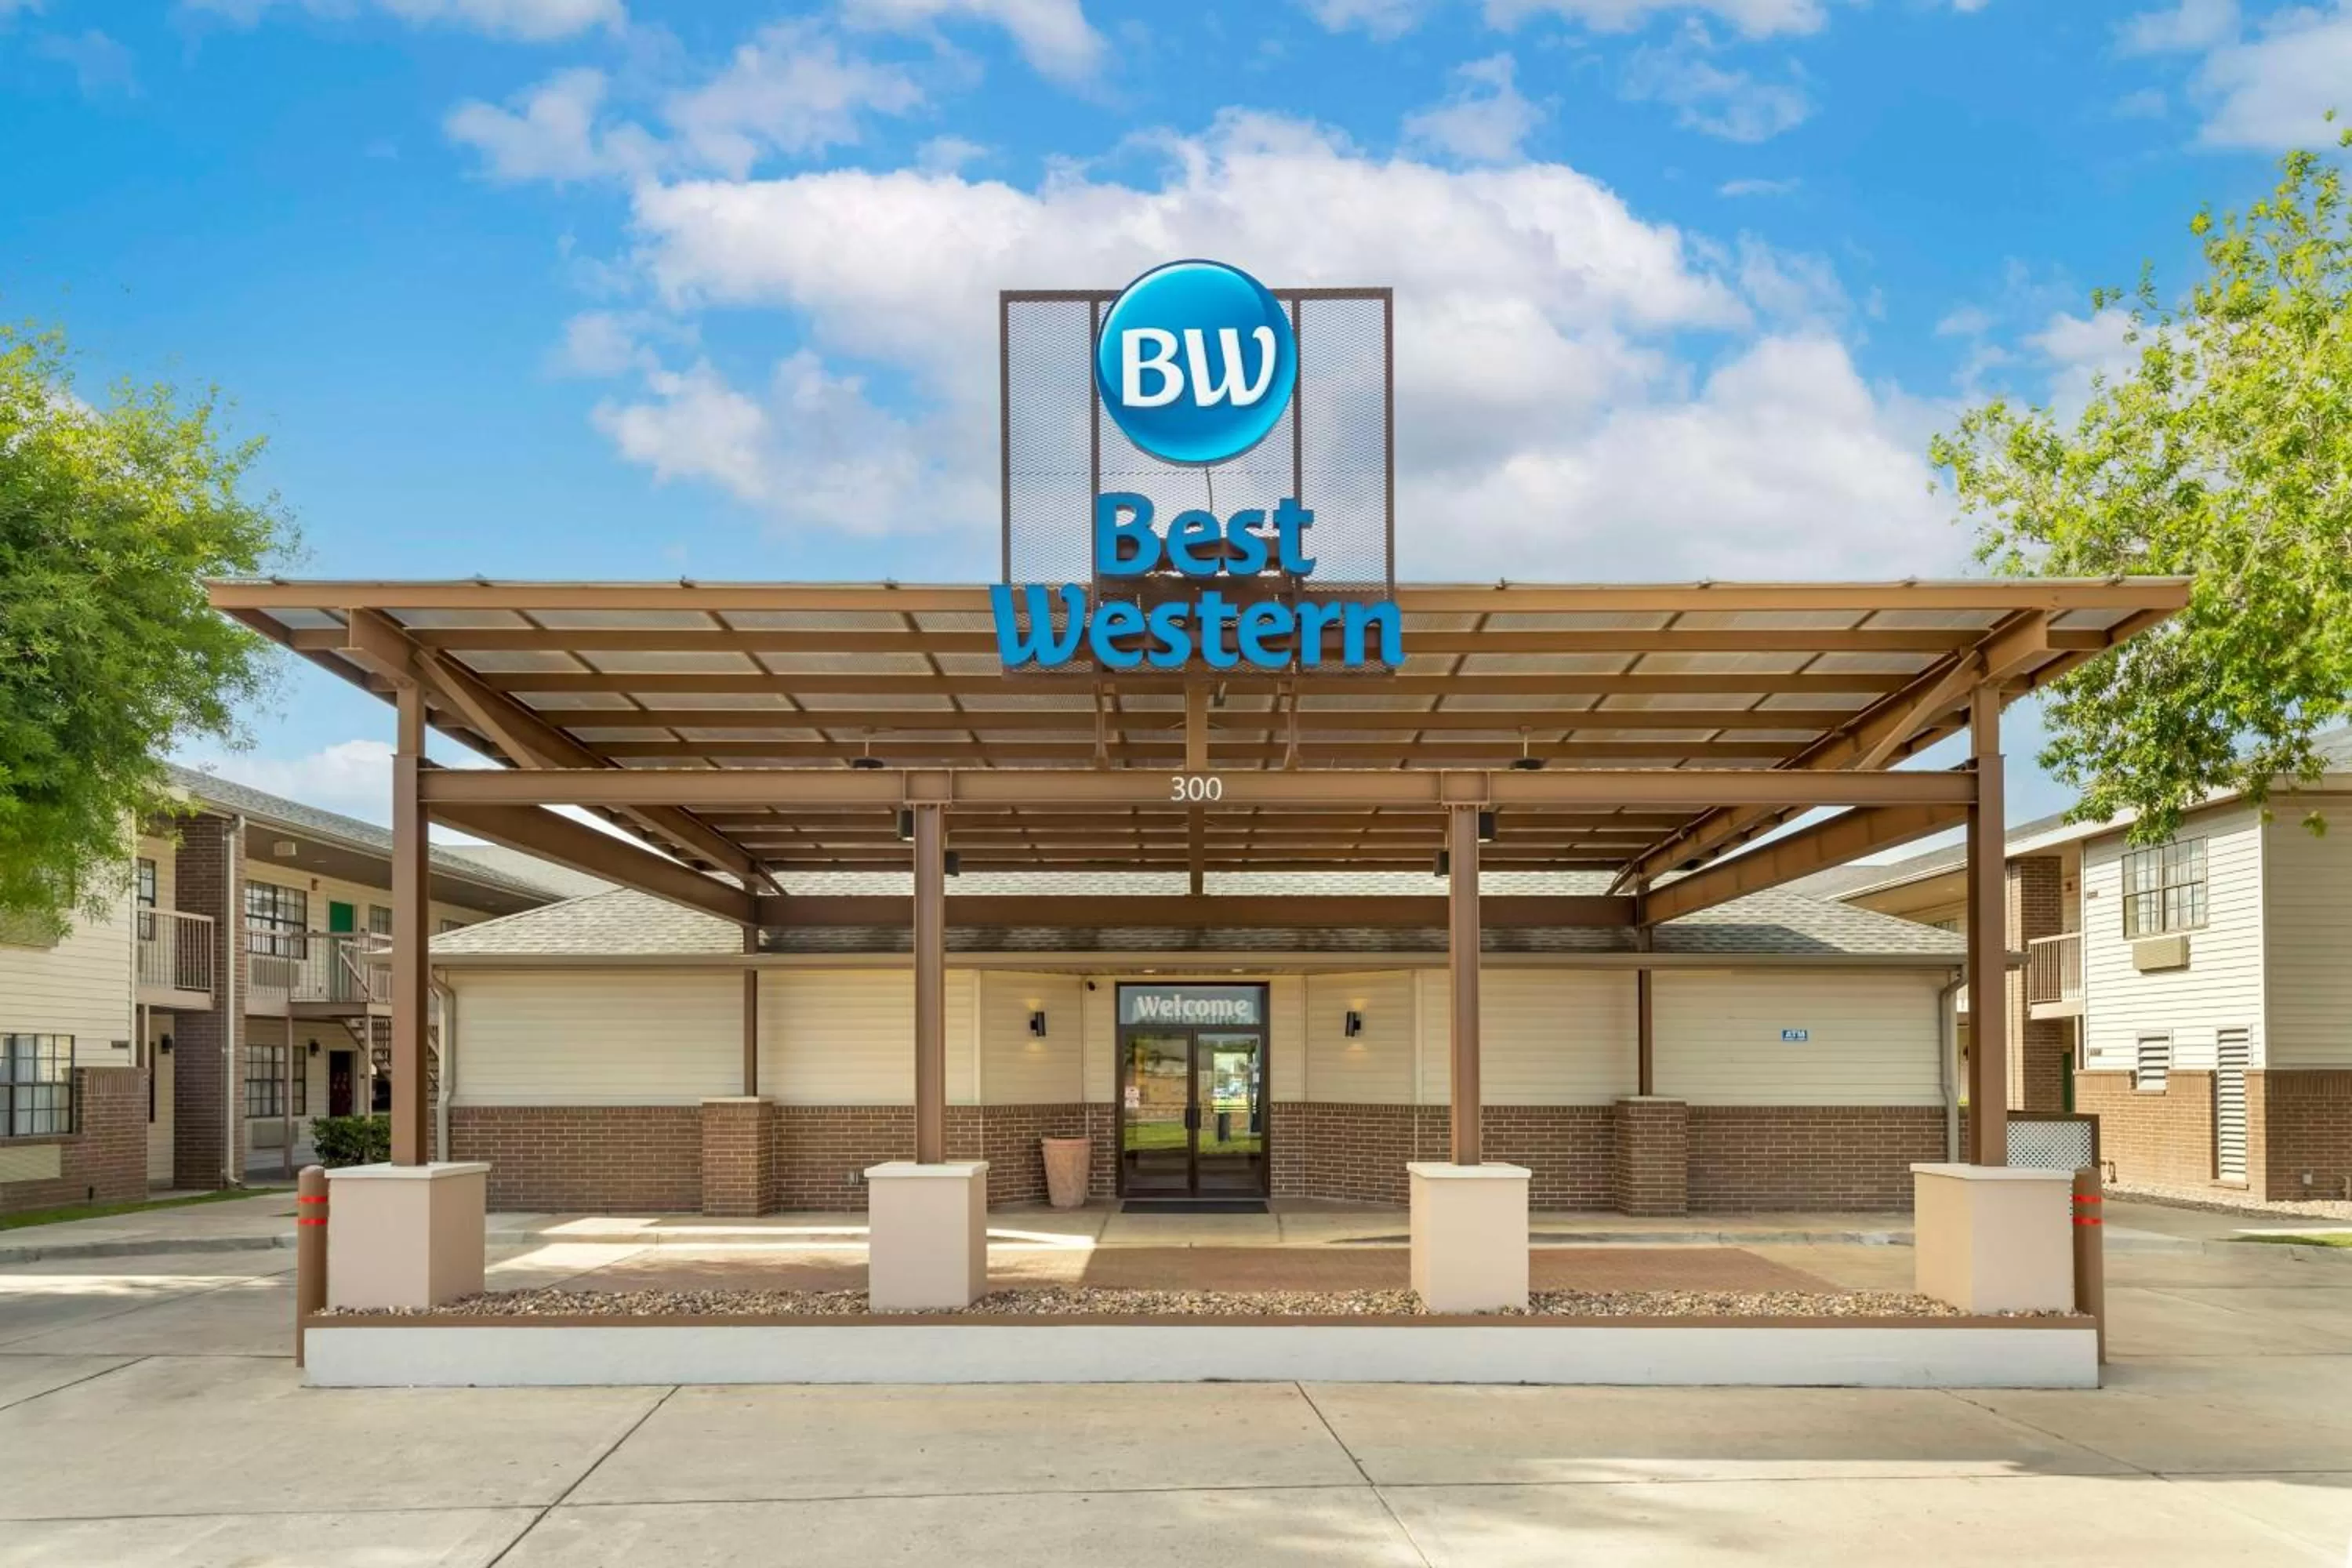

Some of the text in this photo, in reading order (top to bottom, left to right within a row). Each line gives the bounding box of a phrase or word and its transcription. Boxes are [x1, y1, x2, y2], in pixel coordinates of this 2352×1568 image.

[1122, 326, 1276, 407] BW
[1095, 492, 1316, 577] Best
[989, 583, 1406, 670] Western
[1171, 776, 1222, 800] 300
[1137, 994, 1249, 1017] Welcome
